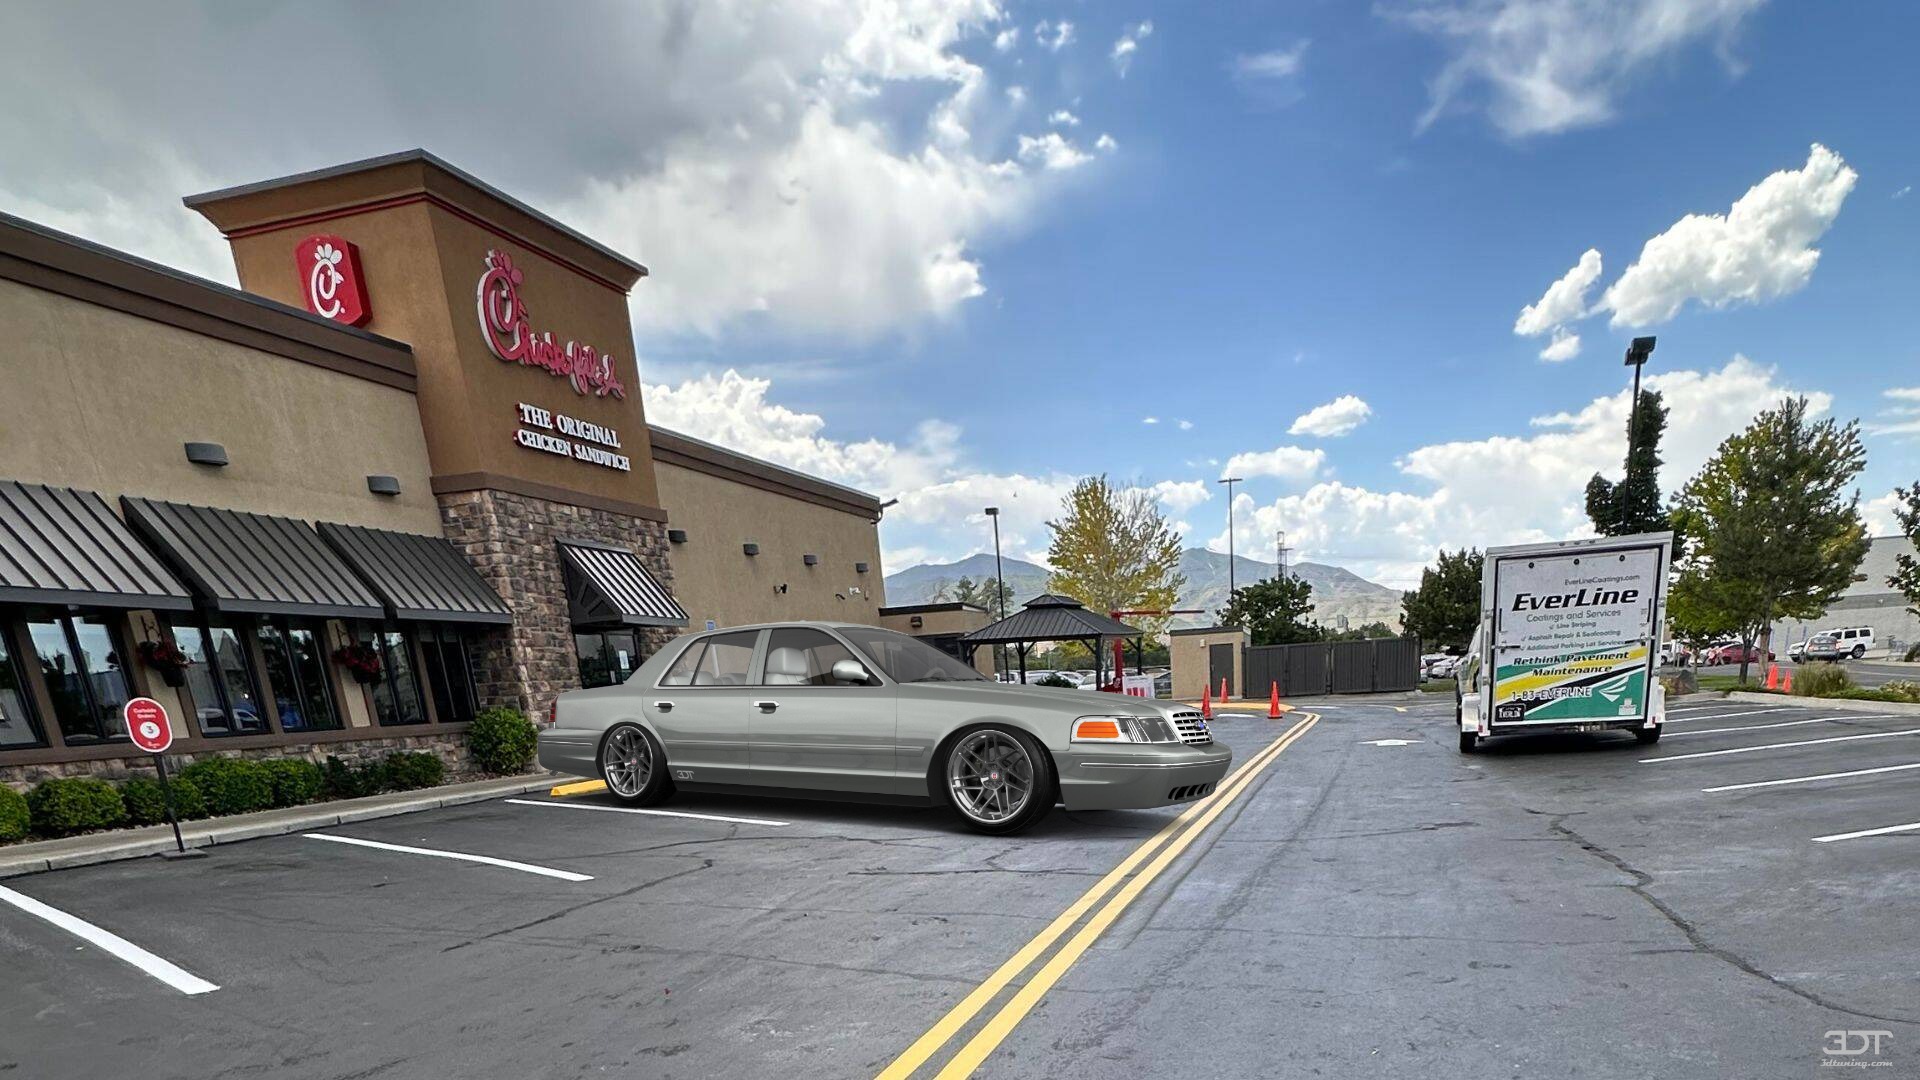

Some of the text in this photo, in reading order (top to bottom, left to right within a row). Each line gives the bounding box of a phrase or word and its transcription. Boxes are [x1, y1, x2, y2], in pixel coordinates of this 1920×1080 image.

[519, 402, 621, 448] THE ORIGINAL
[517, 428, 631, 471] CHICKEN SANDWICH
[1564, 574, 1640, 585] EverLineCoatings.com
[1512, 587, 1639, 611] EverLine
[1526, 609, 1621, 622] Coatings and Services
[1513, 651, 1630, 666] Rethink Pavement
[1532, 665, 1612, 677] Maintenance
[146, 726, 154, 734] 3
